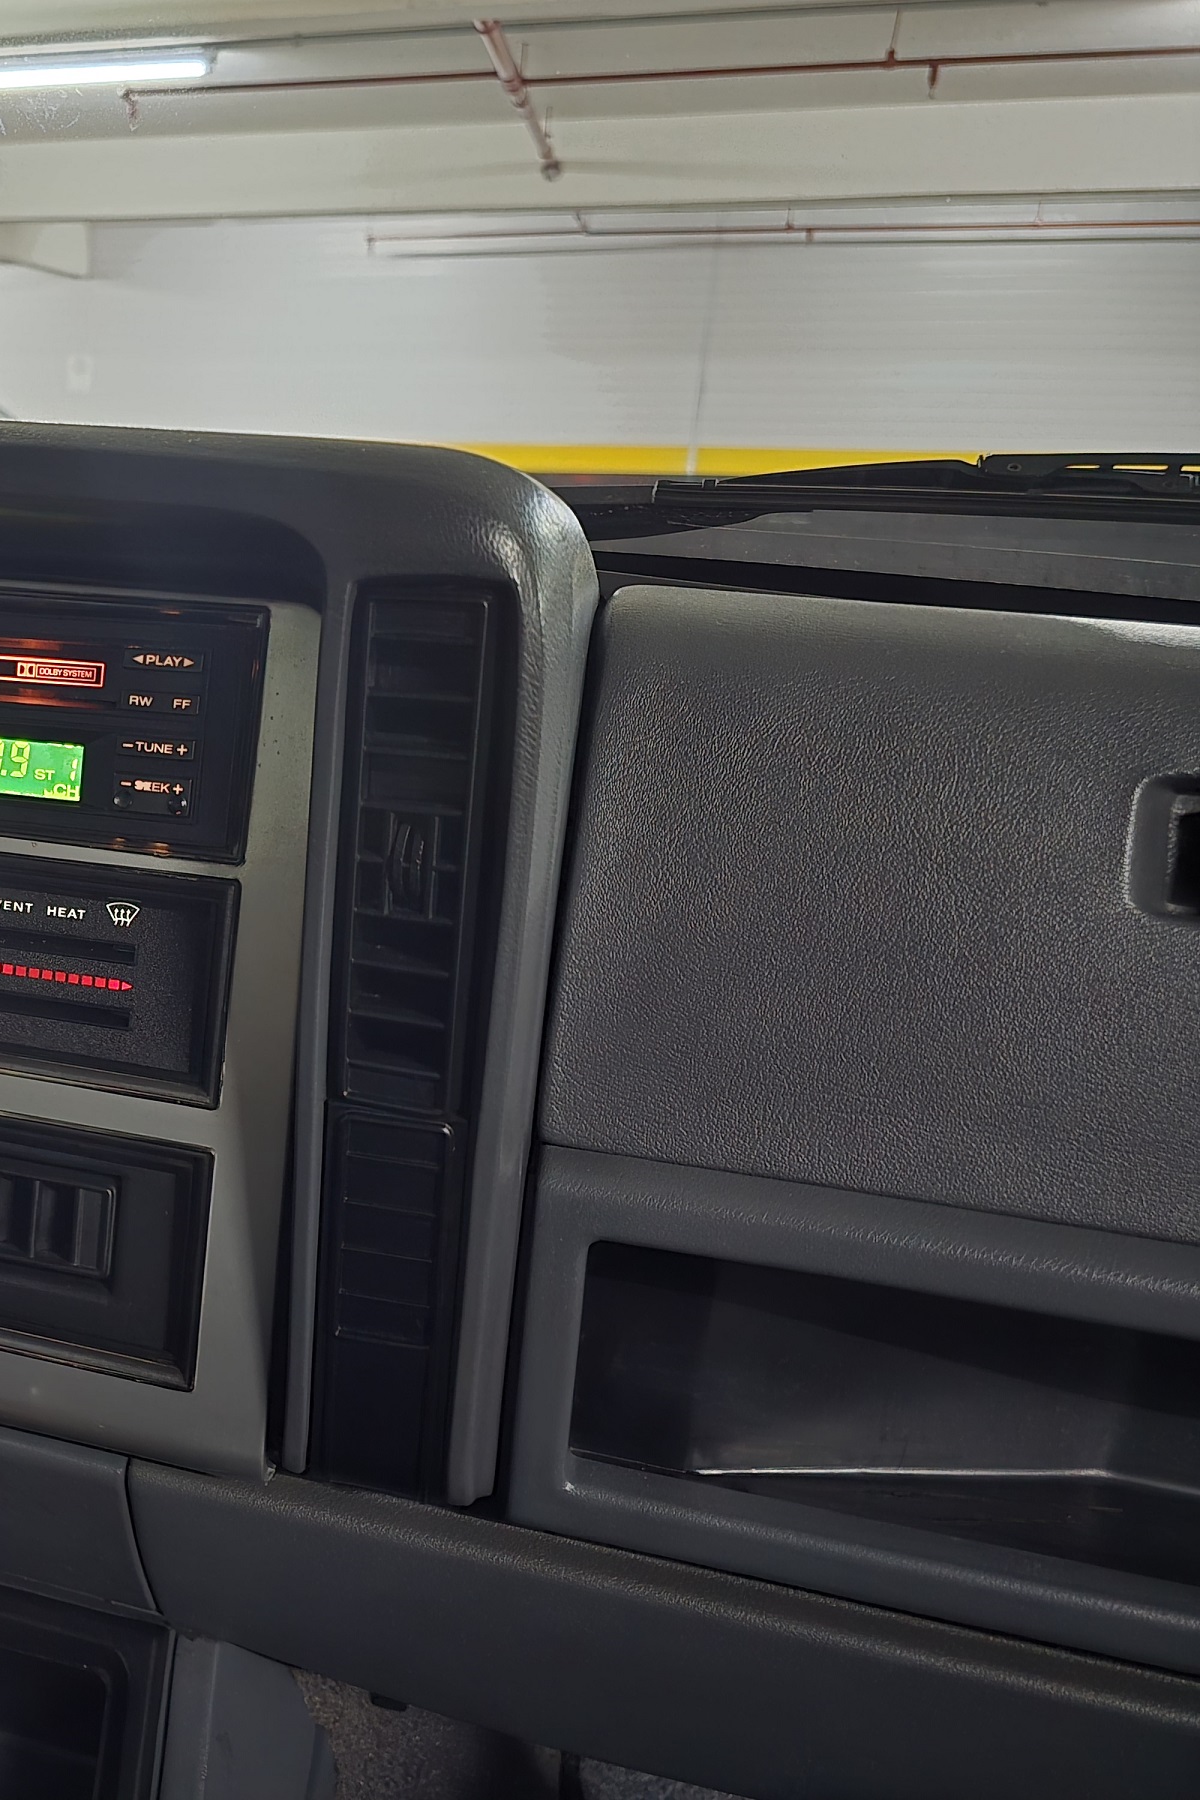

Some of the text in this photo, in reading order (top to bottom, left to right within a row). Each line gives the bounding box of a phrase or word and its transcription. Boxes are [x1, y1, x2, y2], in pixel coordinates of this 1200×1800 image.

[145, 654, 183, 668] PLAY
[38, 666, 93, 679] DOLBY SYSTEM
[128, 695, 153, 707] RW
[172, 698, 192, 710] FF
[135, 741, 174, 755] TUNE
[34, 769, 55, 781] ST
[52, 783, 80, 798] CH
[46, 905, 87, 920] HEAT
